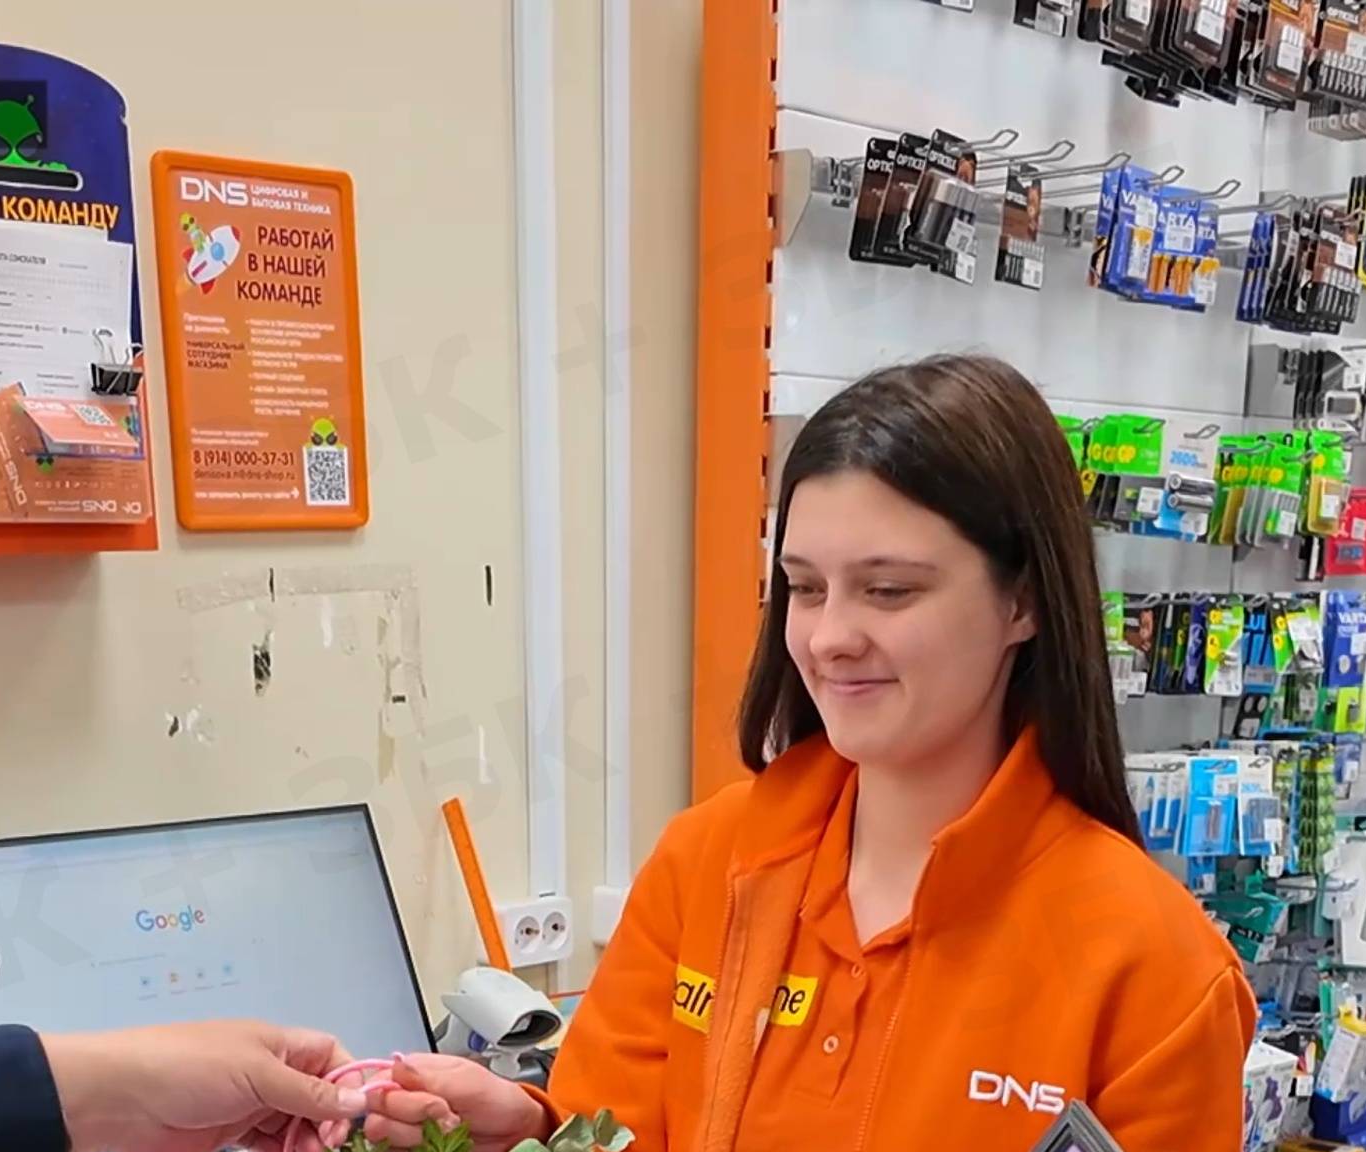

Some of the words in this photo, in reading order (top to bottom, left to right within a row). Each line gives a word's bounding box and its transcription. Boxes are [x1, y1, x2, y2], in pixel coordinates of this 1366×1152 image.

[180, 176, 249, 207] DNS
[2, 195, 119, 230] КОМАНДУ
[258, 225, 335, 251] РАБОТАЙ
[248, 253, 258, 272] В
[263, 254, 326, 278] НАШЕЙ
[237, 280, 323, 308] КОМАНДЕ
[194, 450, 201, 464] 8
[204, 450, 232, 467] (914)
[234, 450, 295, 466] 000-37-31
[135, 904, 206, 932] Google
[969, 1070, 1065, 1115] DNS
